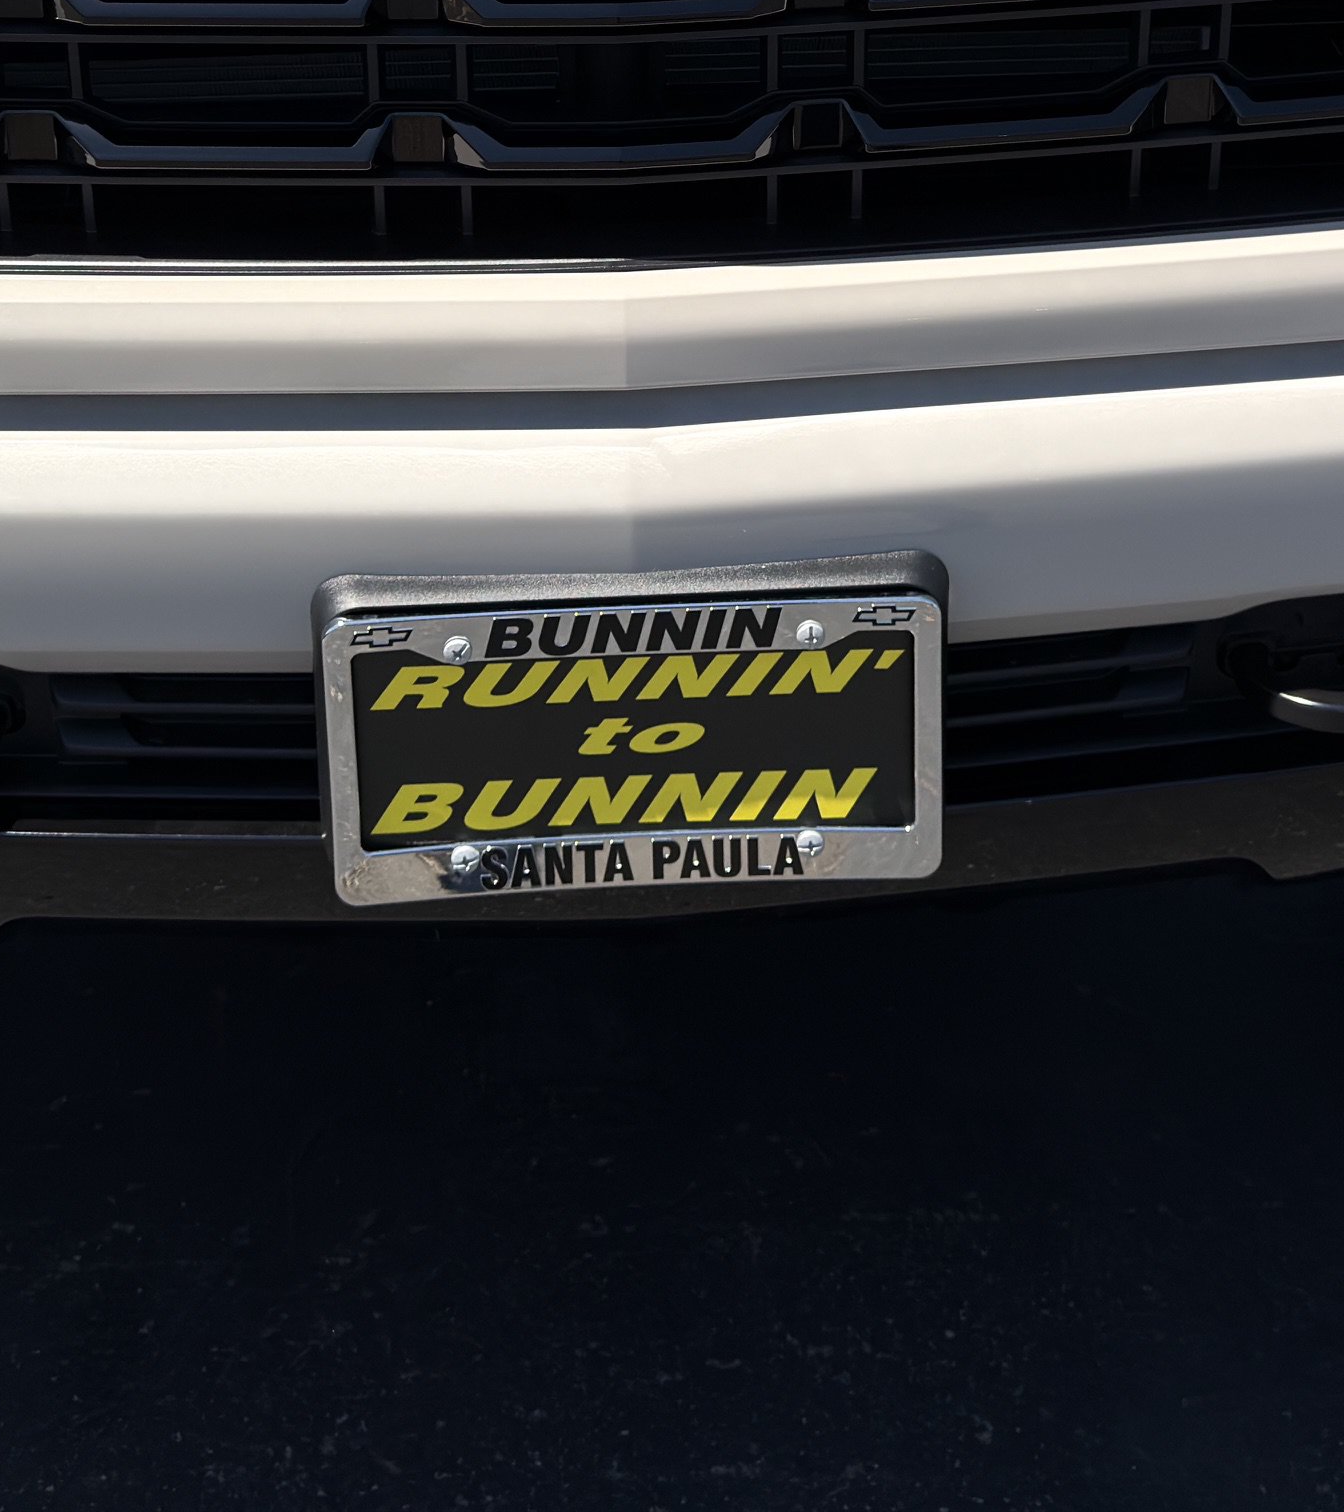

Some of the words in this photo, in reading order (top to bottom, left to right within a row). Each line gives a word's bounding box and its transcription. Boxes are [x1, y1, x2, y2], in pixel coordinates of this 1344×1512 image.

[484, 606, 783, 659] BUNNIN
[369, 648, 906, 712] RUNNIN'
[577, 717, 706, 756] to
[369, 767, 878, 836] BUNNIN
[480, 839, 635, 890] SANTA
[652, 834, 805, 880] PAULA
